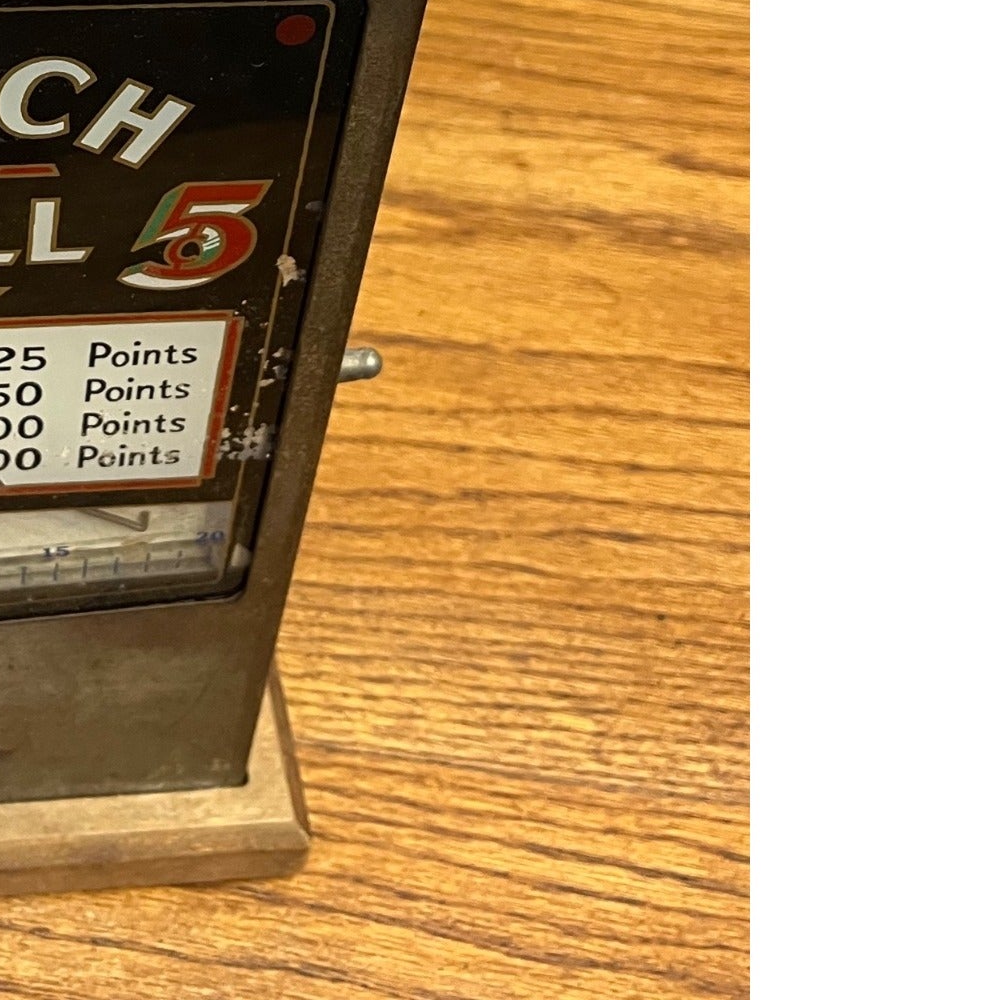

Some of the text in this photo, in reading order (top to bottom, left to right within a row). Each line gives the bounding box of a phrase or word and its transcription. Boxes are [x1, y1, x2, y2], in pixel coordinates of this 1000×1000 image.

[88, 341, 198, 368] Points
[84, 377, 191, 402] Points
[81, 411, 186, 437] Points
[77, 445, 180, 468] Points
[43, 545, 70, 558] 15
[195, 530, 224, 545] 20
